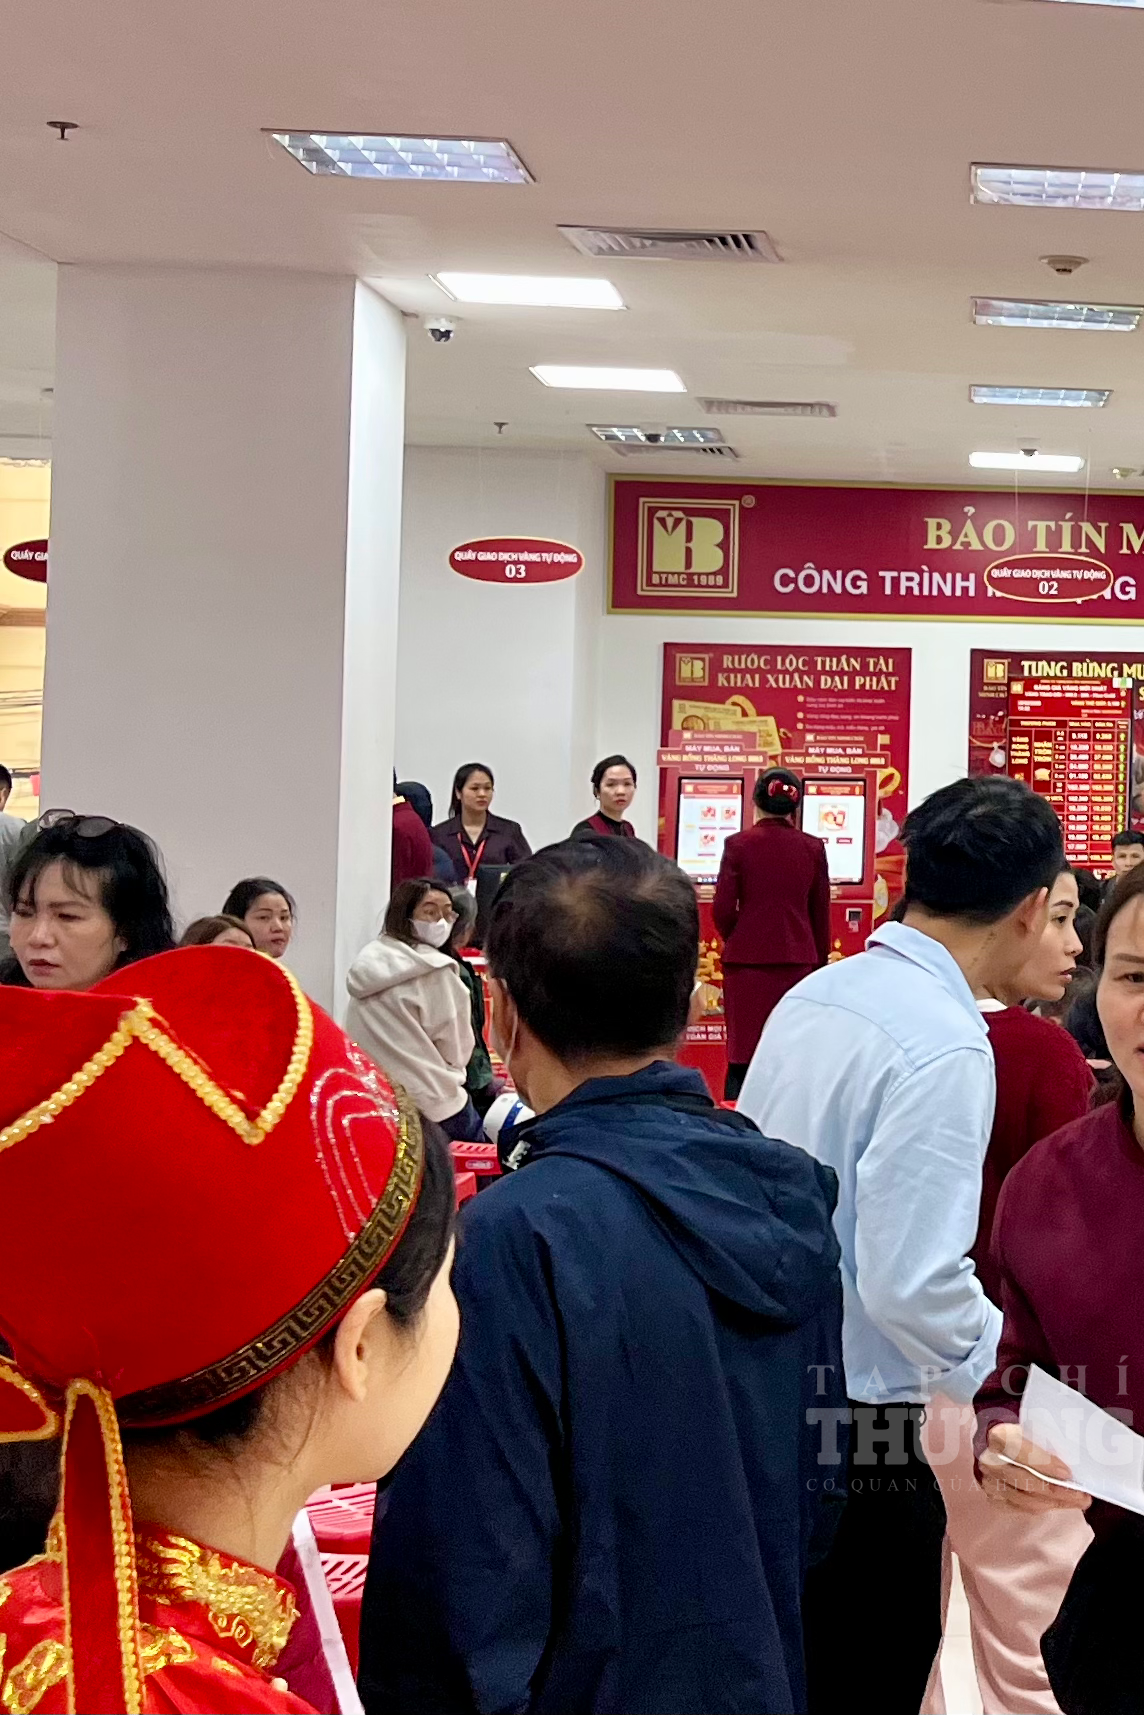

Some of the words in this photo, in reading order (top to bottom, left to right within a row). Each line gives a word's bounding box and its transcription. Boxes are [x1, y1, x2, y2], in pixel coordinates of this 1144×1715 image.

[923, 506, 1016, 551] BẢO
[1028, 512, 1109, 554] TÍN
[505, 564, 526, 578] 03
[652, 573, 687, 585] BTMC
[774, 562, 868, 595] CÔNG
[879, 565, 976, 597] TRÌNH
[1039, 581, 1058, 595] 02
[723, 653, 770, 670] RƯỚC
[777, 654, 808, 672] LỘC
[866, 656, 893, 672] TÀI
[718, 673, 760, 688] KHAI
[765, 673, 814, 689] XUÂN
[855, 674, 899, 691] PHÁT
